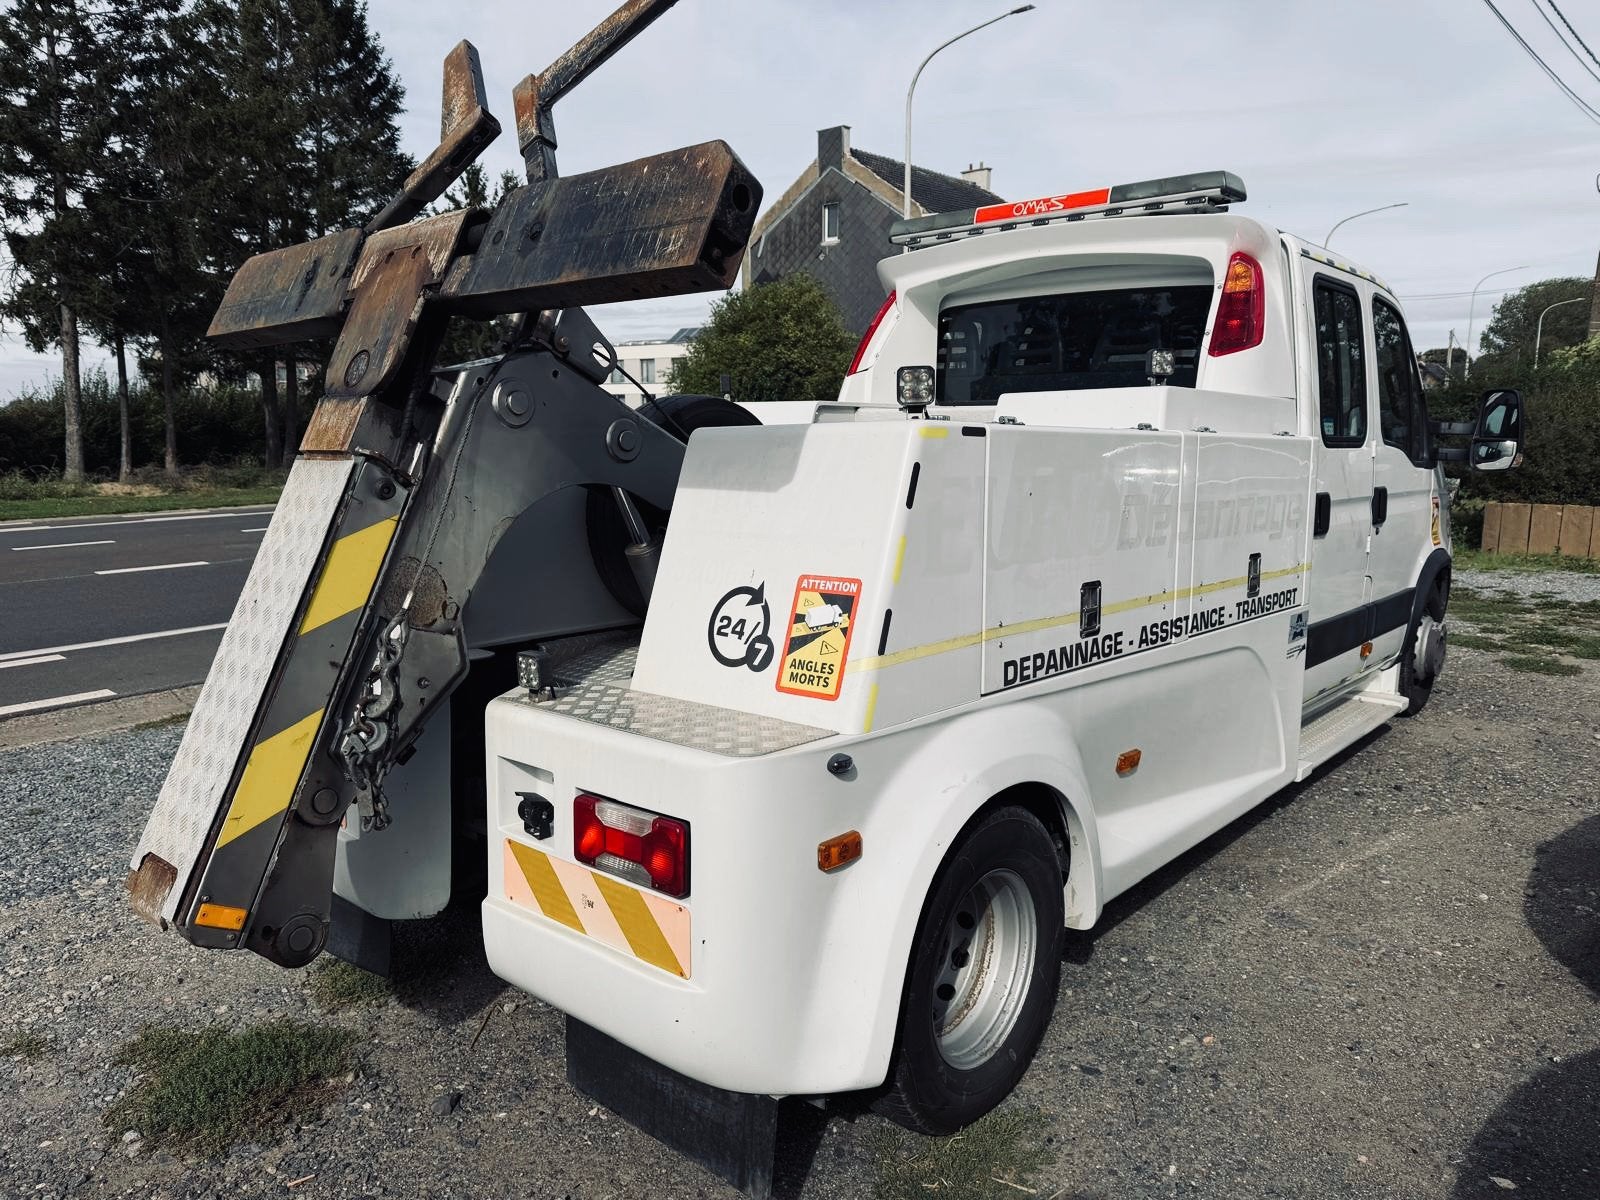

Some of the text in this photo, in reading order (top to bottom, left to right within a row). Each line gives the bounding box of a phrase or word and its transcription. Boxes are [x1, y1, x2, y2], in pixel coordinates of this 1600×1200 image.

[801, 579, 858, 593] ATTENTION
[1003, 632, 1123, 687] DEPANNAGE
[1138, 606, 1225, 649] ASSISTANCE
[1236, 588, 1298, 620] TRANSPORT
[789, 658, 835, 675] ANGLES
[789, 672, 830, 688] MORTS
